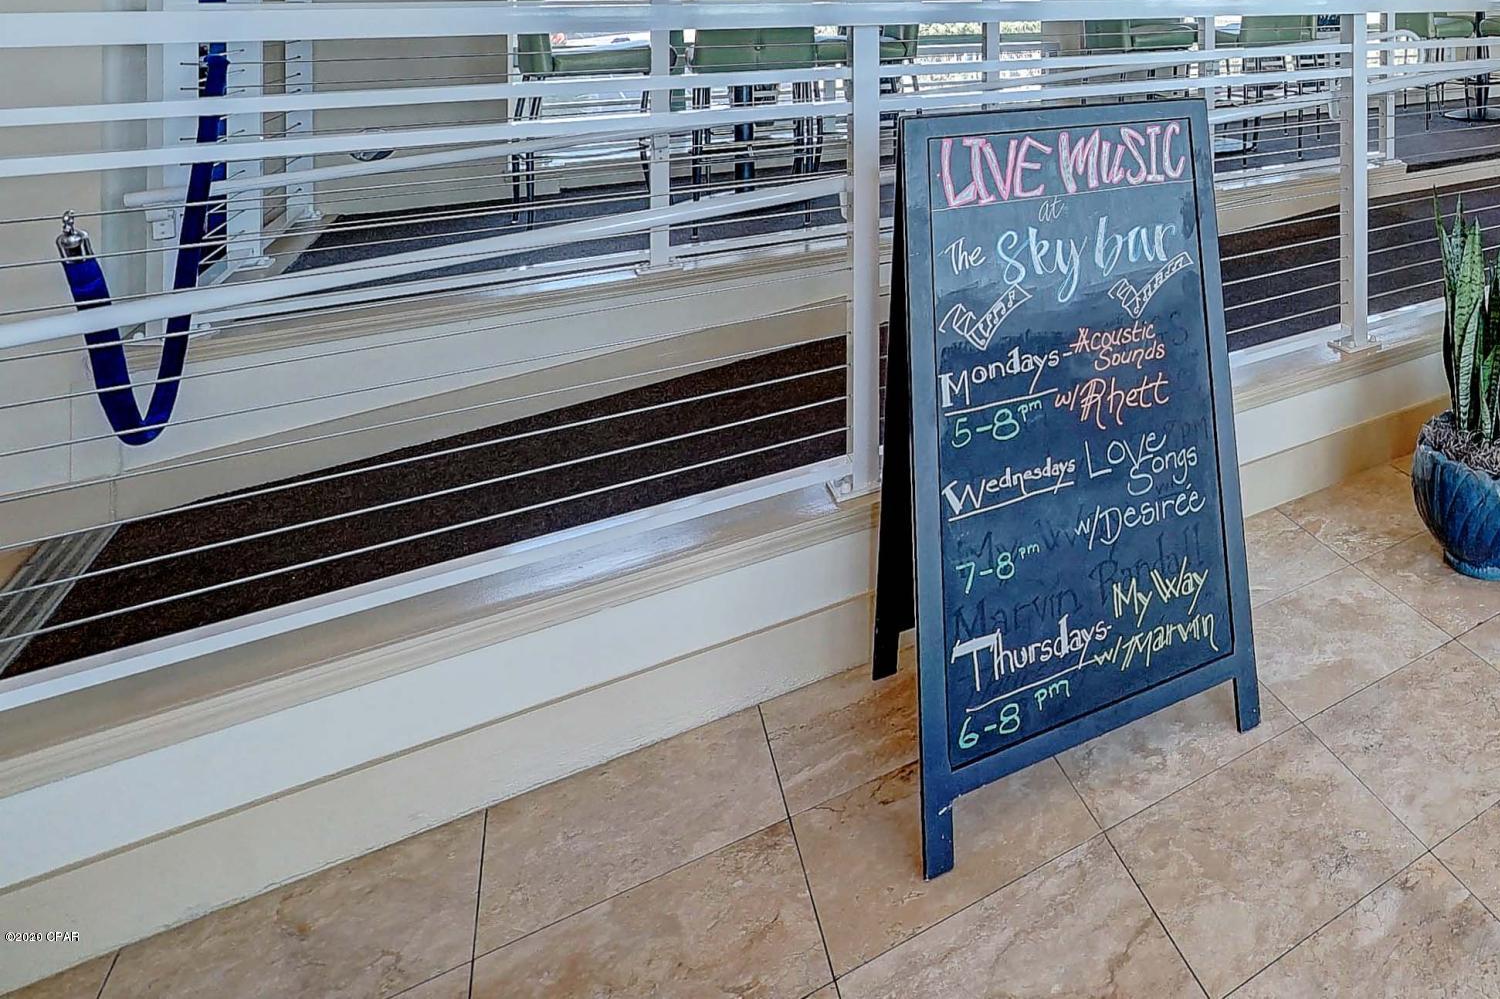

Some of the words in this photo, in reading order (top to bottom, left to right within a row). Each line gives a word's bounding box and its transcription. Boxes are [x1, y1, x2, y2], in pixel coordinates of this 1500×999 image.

[940, 136, 1052, 207] LIVE
[1039, 197, 1064, 222] at
[943, 236, 986, 276] The
[1095, 340, 1165, 371] Sounds
[941, 457, 1076, 515] Wednesdays
